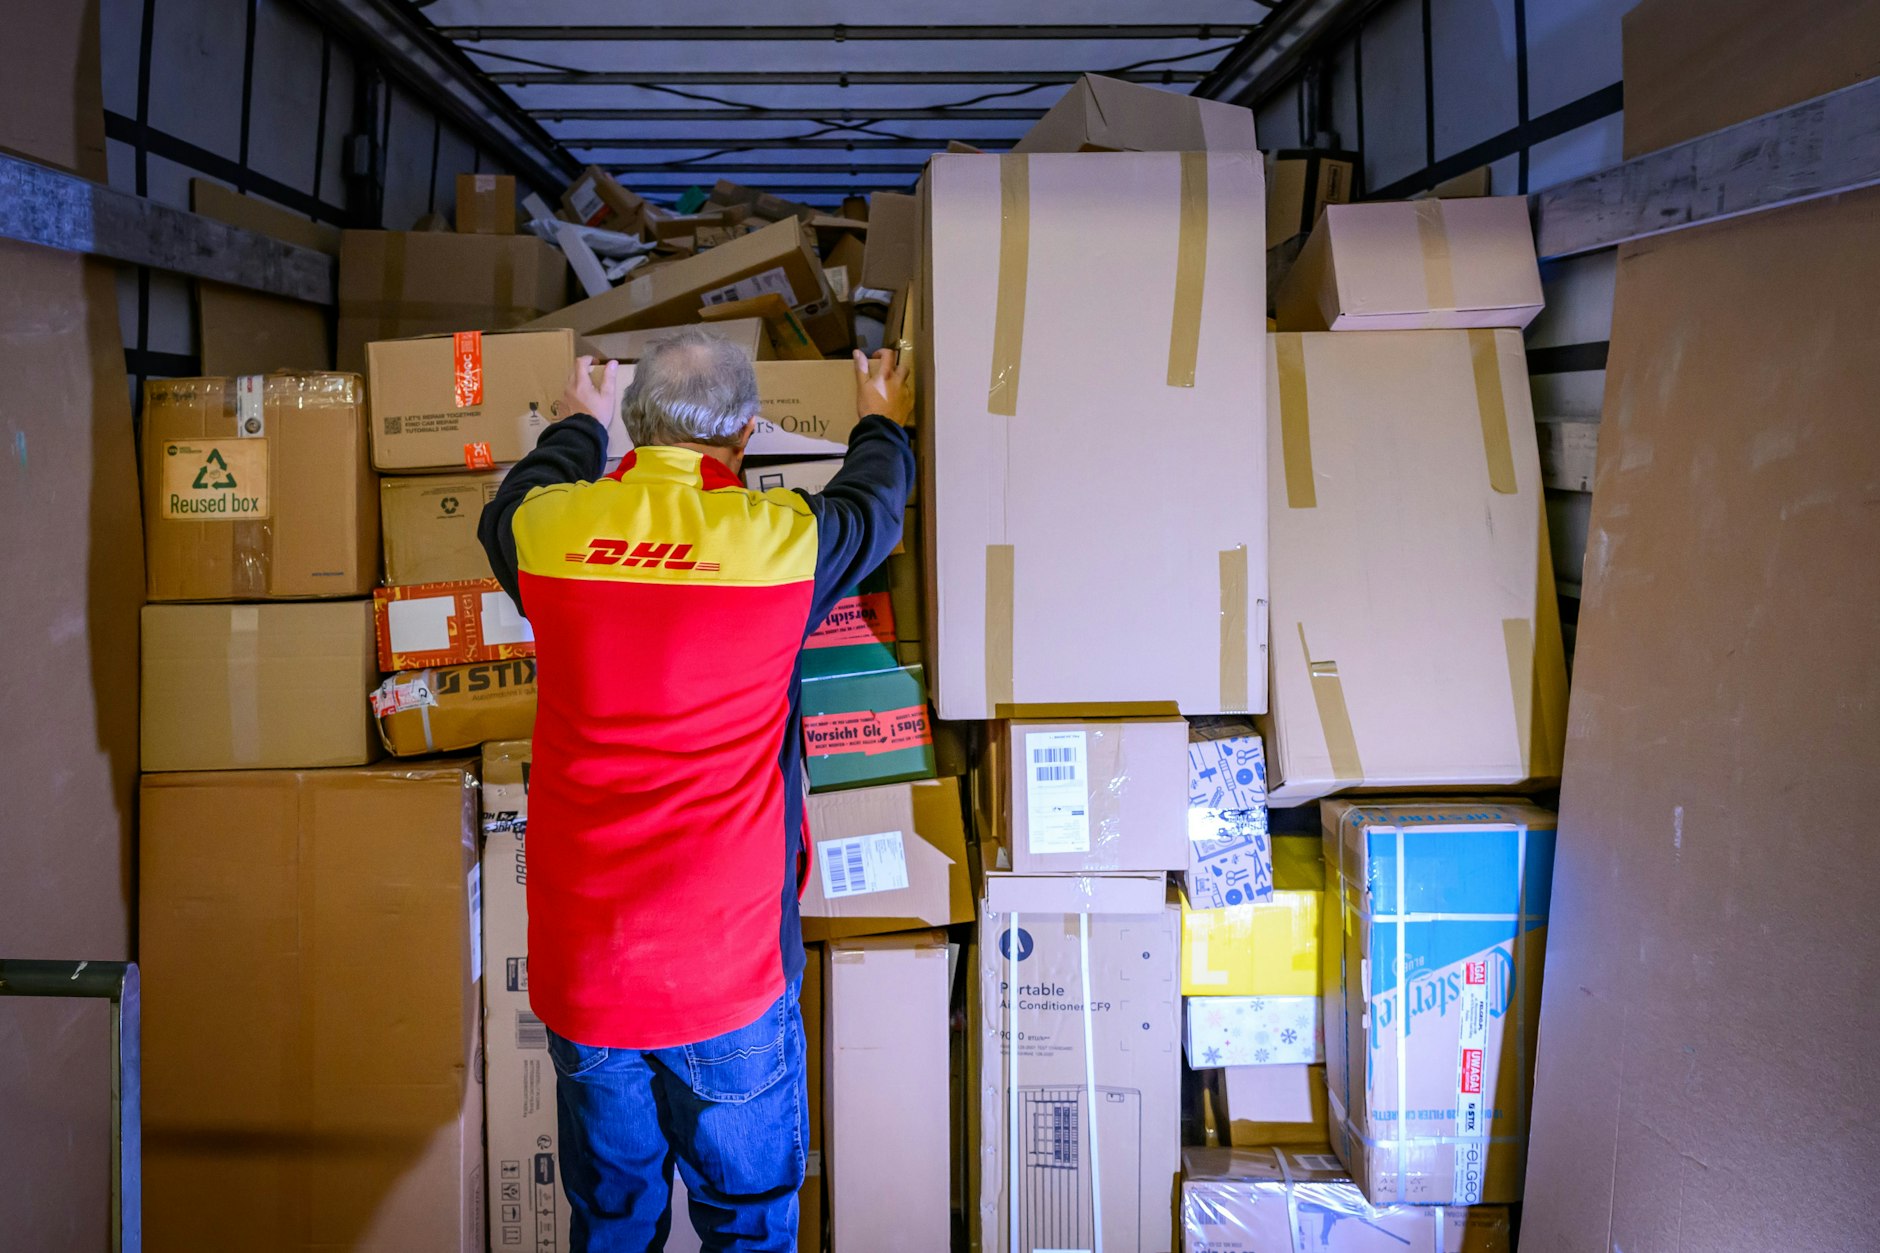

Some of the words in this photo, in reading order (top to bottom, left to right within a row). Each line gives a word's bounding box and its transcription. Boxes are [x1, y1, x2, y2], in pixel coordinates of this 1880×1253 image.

[781, 415, 830, 437] Only
[170, 493, 226, 514] Reused
[231, 493, 259, 513] box
[585, 538, 697, 570] DHL
[826, 608, 877, 626] Vorsicht
[806, 726, 858, 742] Vorsicht
[898, 719, 926, 734] Glas
[1000, 982, 1065, 997] Prtable
[1000, 1000, 1011, 1010] Ai
[1019, 1000, 1085, 1012] Conditioner
[1090, 1001, 1111, 1012] CF9
[1000, 1030, 1025, 1041] 900
[1470, 1050, 1482, 1092] UWAGA!
[1419, 1109, 1444, 1120] FILTER
[1467, 1111, 1476, 1131] STIX
